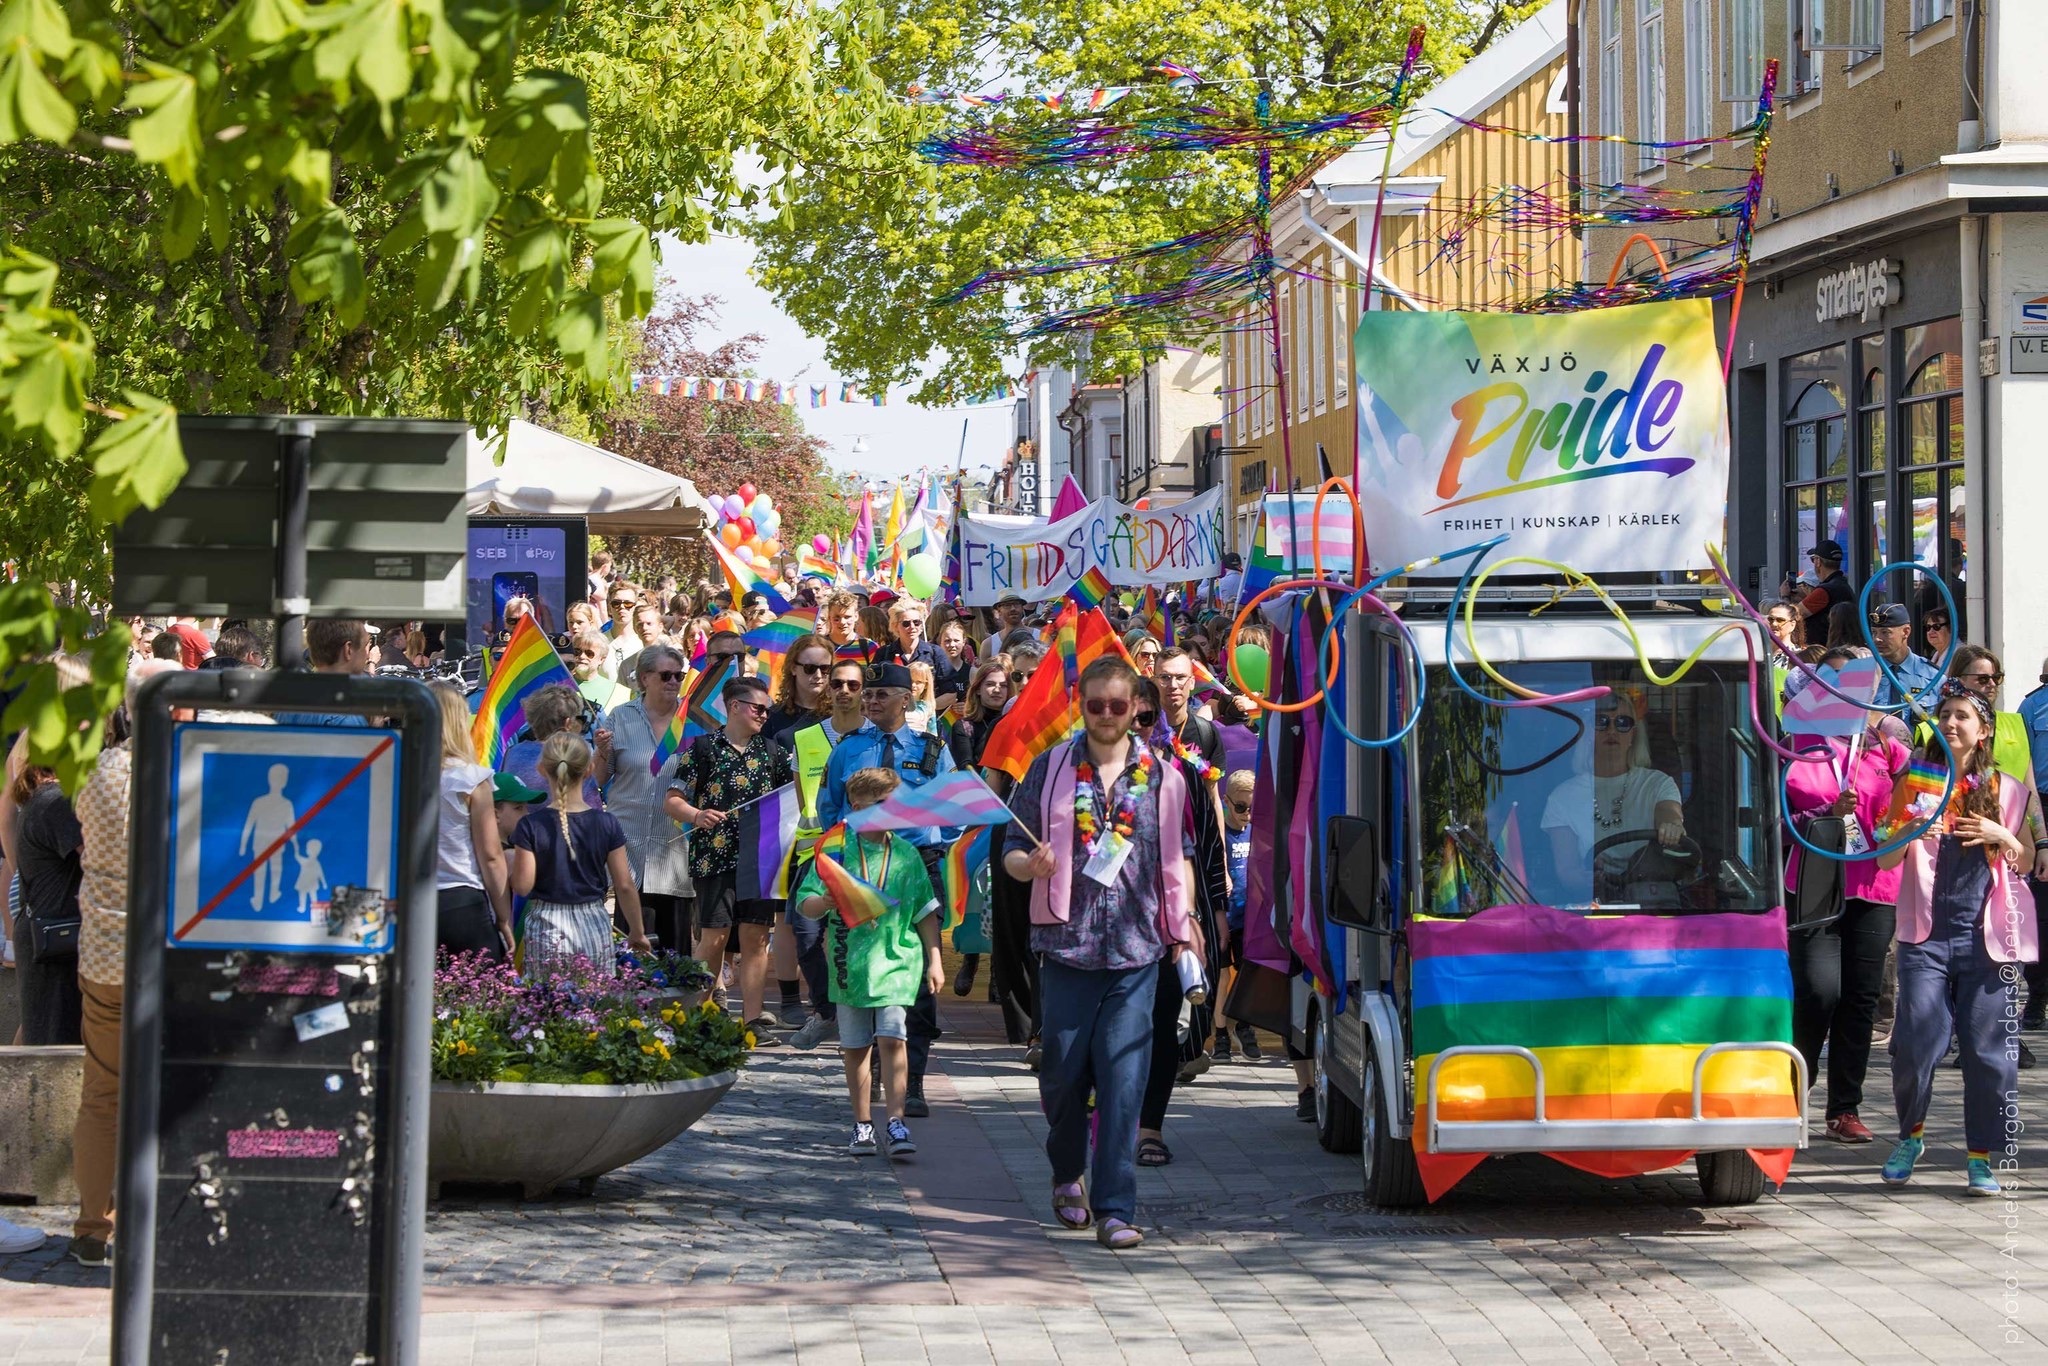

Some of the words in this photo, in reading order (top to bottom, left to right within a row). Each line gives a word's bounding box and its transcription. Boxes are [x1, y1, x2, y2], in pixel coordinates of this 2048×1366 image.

[1816, 257, 1887, 323] smarteyes
[2019, 339, 2034, 353] V.
[1465, 351, 1577, 375] VÄXJÖ
[1436, 343, 1684, 500] Pride
[1443, 517, 1504, 531] FRIHET
[1522, 515, 1601, 529] KUNSKAP
[1618, 512, 1681, 526] KÄRLEK
[476, 547, 508, 559] SEB
[535, 548, 556, 560] Pay
